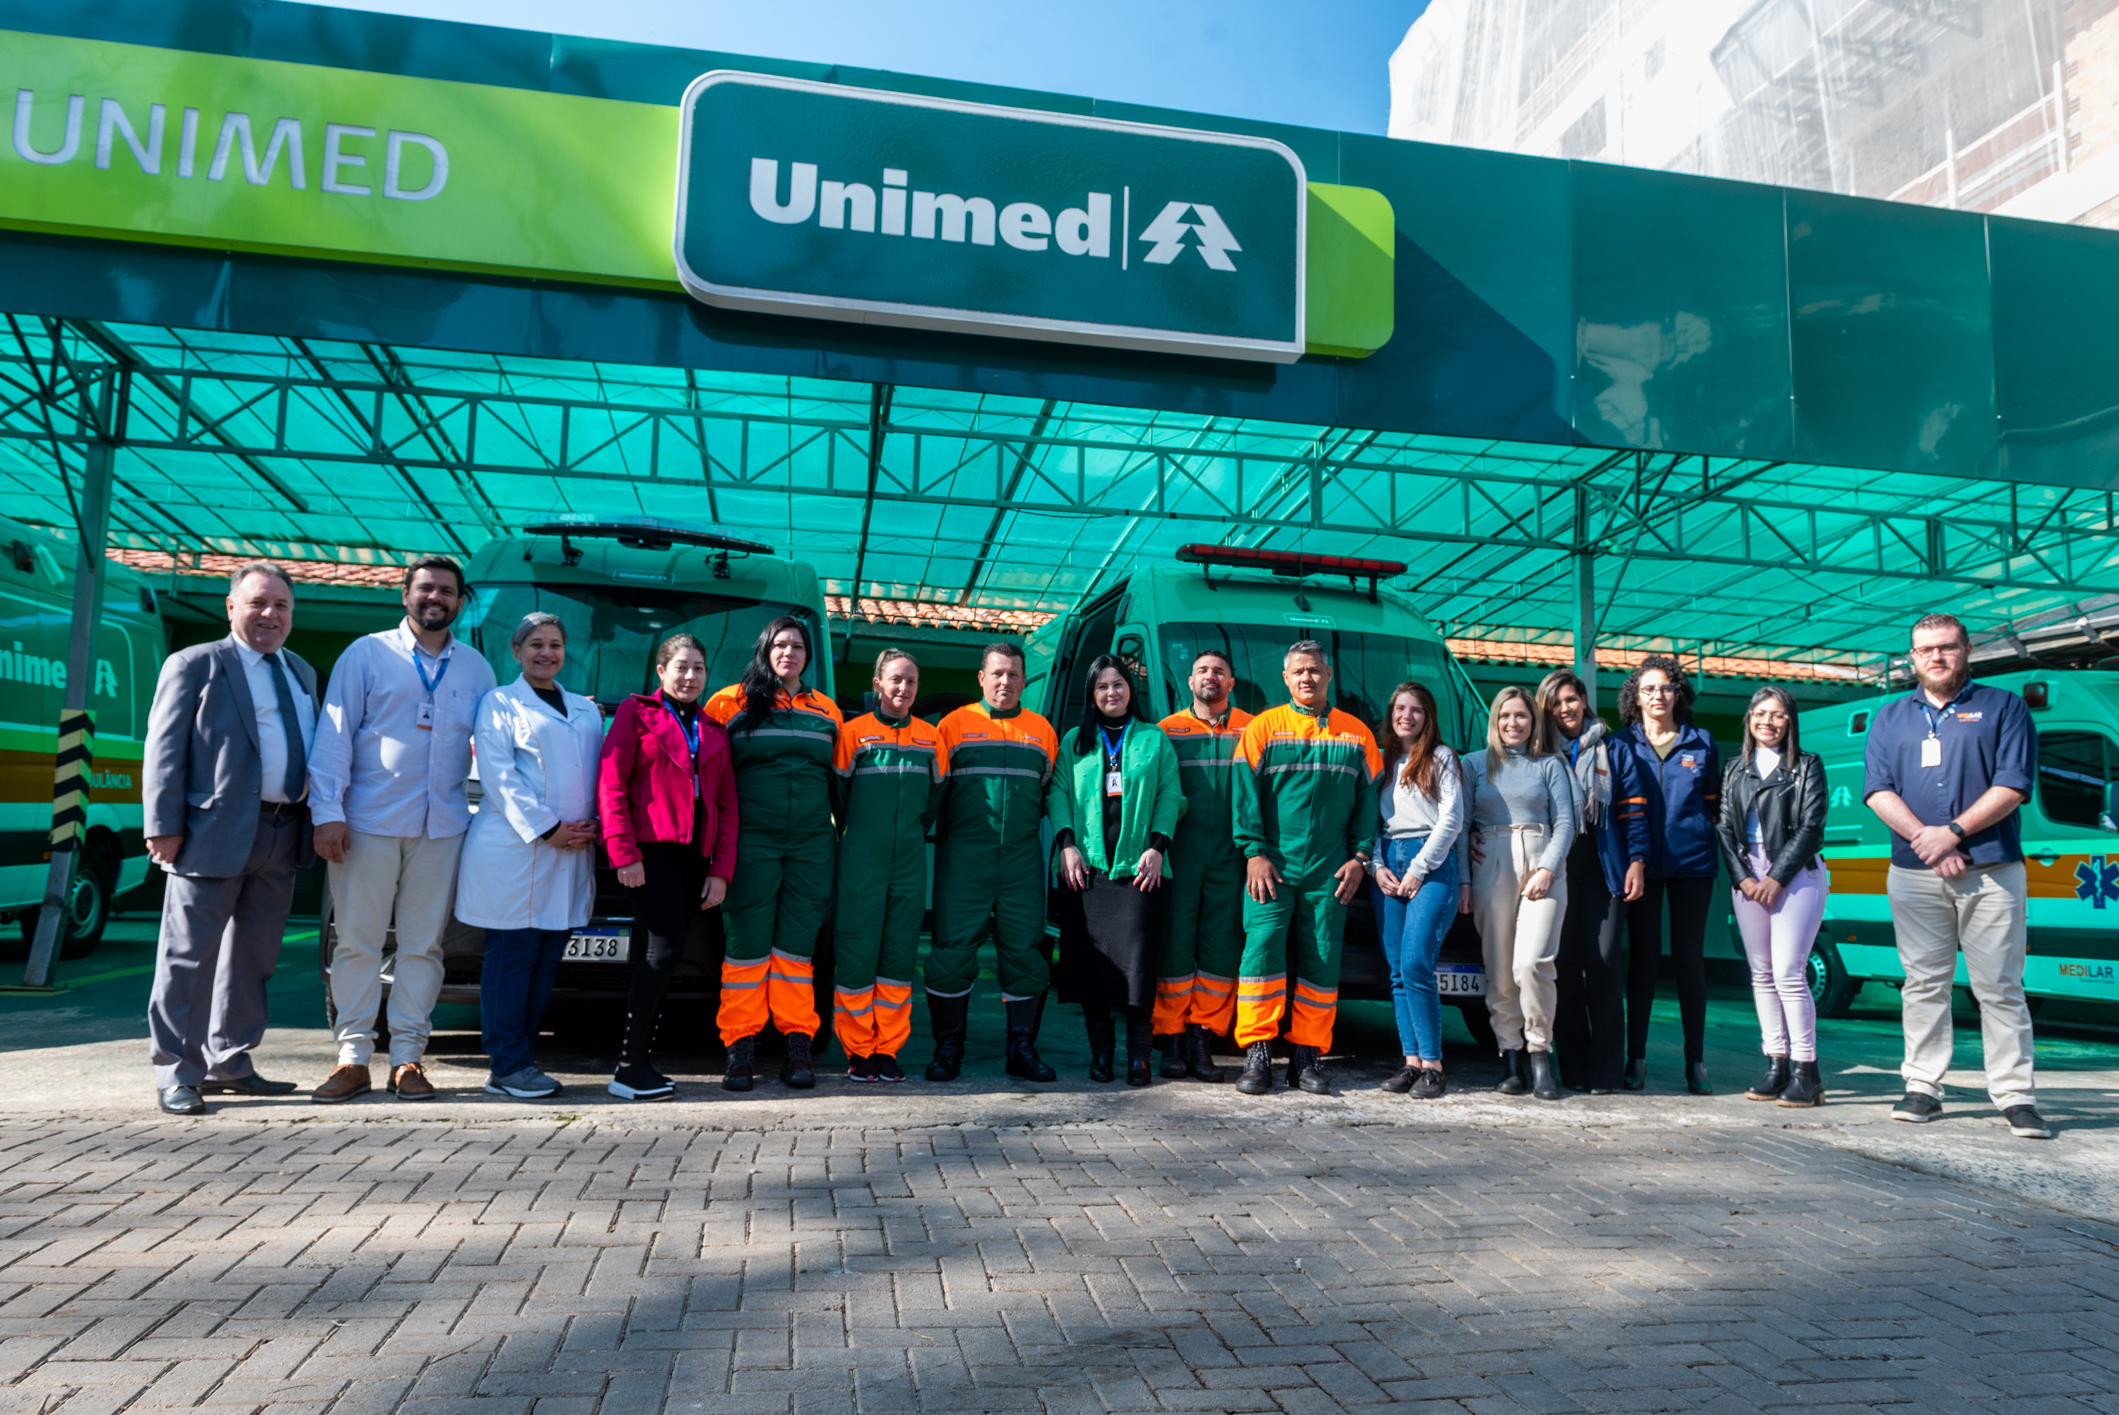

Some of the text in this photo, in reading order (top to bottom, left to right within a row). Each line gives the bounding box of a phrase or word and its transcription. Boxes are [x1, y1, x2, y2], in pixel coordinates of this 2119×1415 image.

[12, 88, 449, 200] UNIMED
[749, 157, 1111, 258] Unimed
[0, 640, 67, 689] nime
[89, 769, 132, 789] ULÂNCIA
[567, 937, 618, 957] 3I38
[2059, 964, 2114, 979] MEDILAR
[1439, 974, 1479, 992] 5I84
